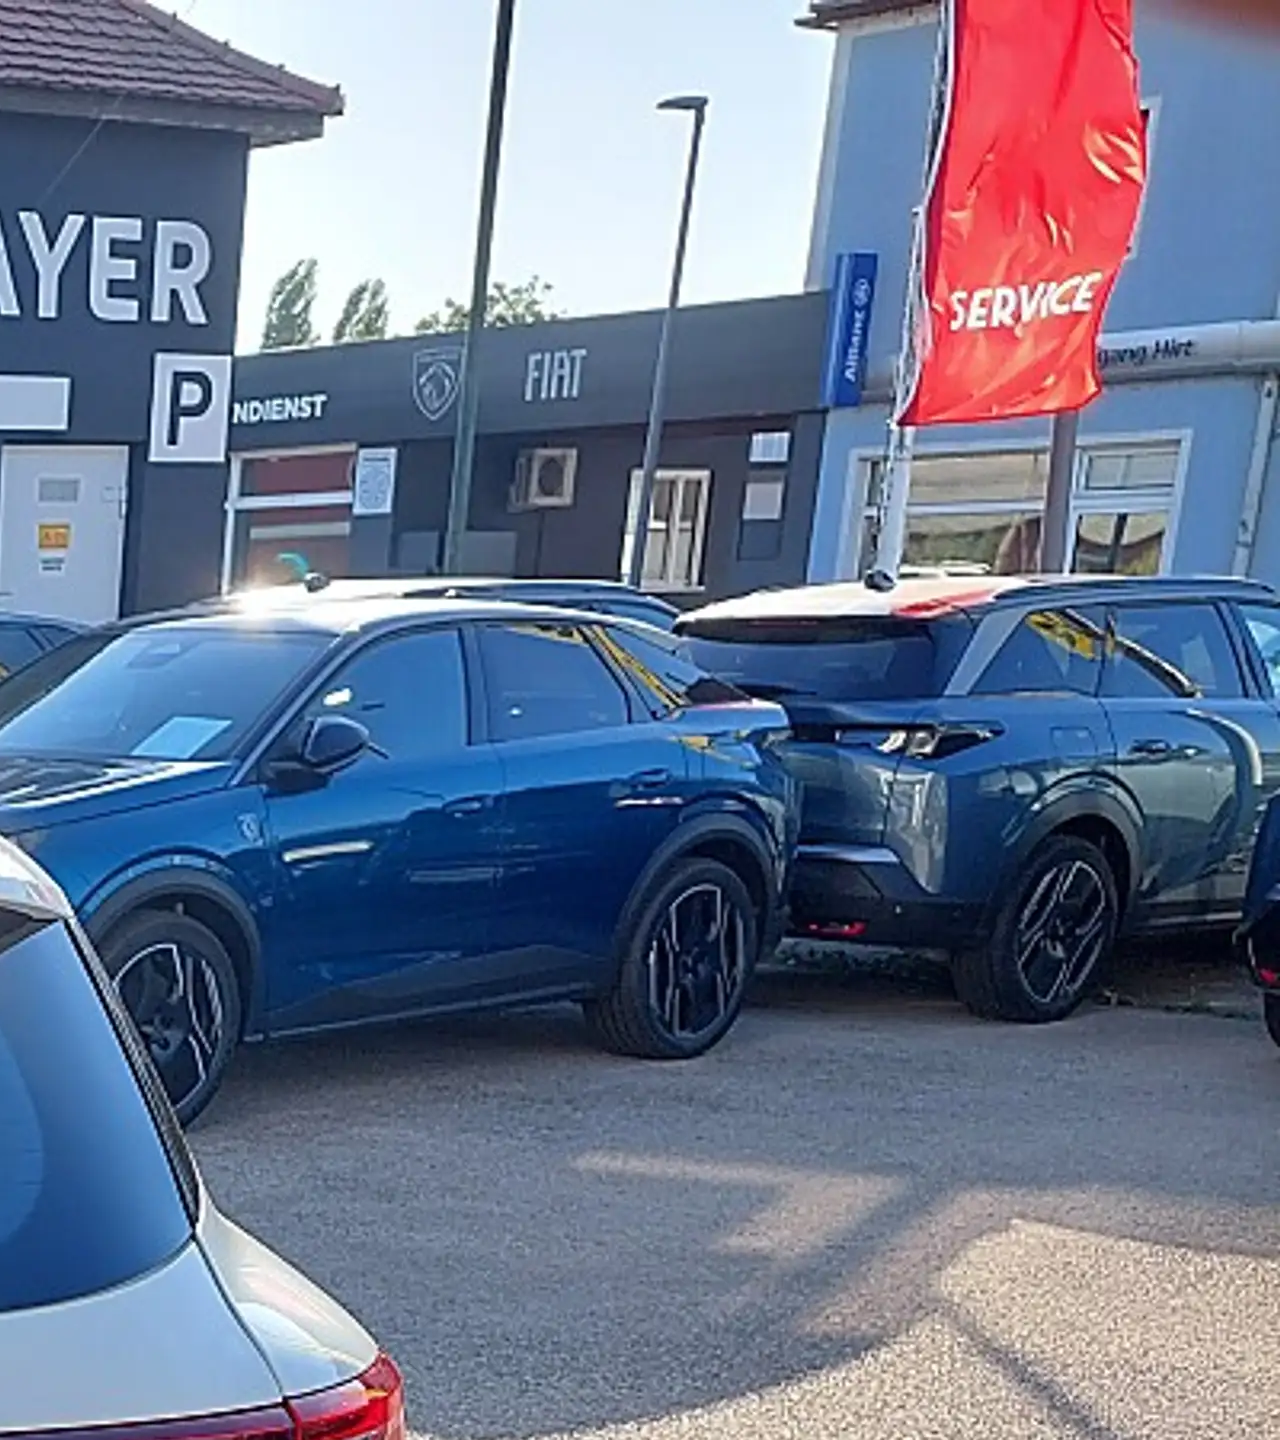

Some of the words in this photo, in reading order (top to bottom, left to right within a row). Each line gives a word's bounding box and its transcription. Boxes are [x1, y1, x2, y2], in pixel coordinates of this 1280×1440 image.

[950, 271, 1102, 331] SERVICE
[524, 348, 587, 401] FIAT
[167, 371, 213, 446] P
